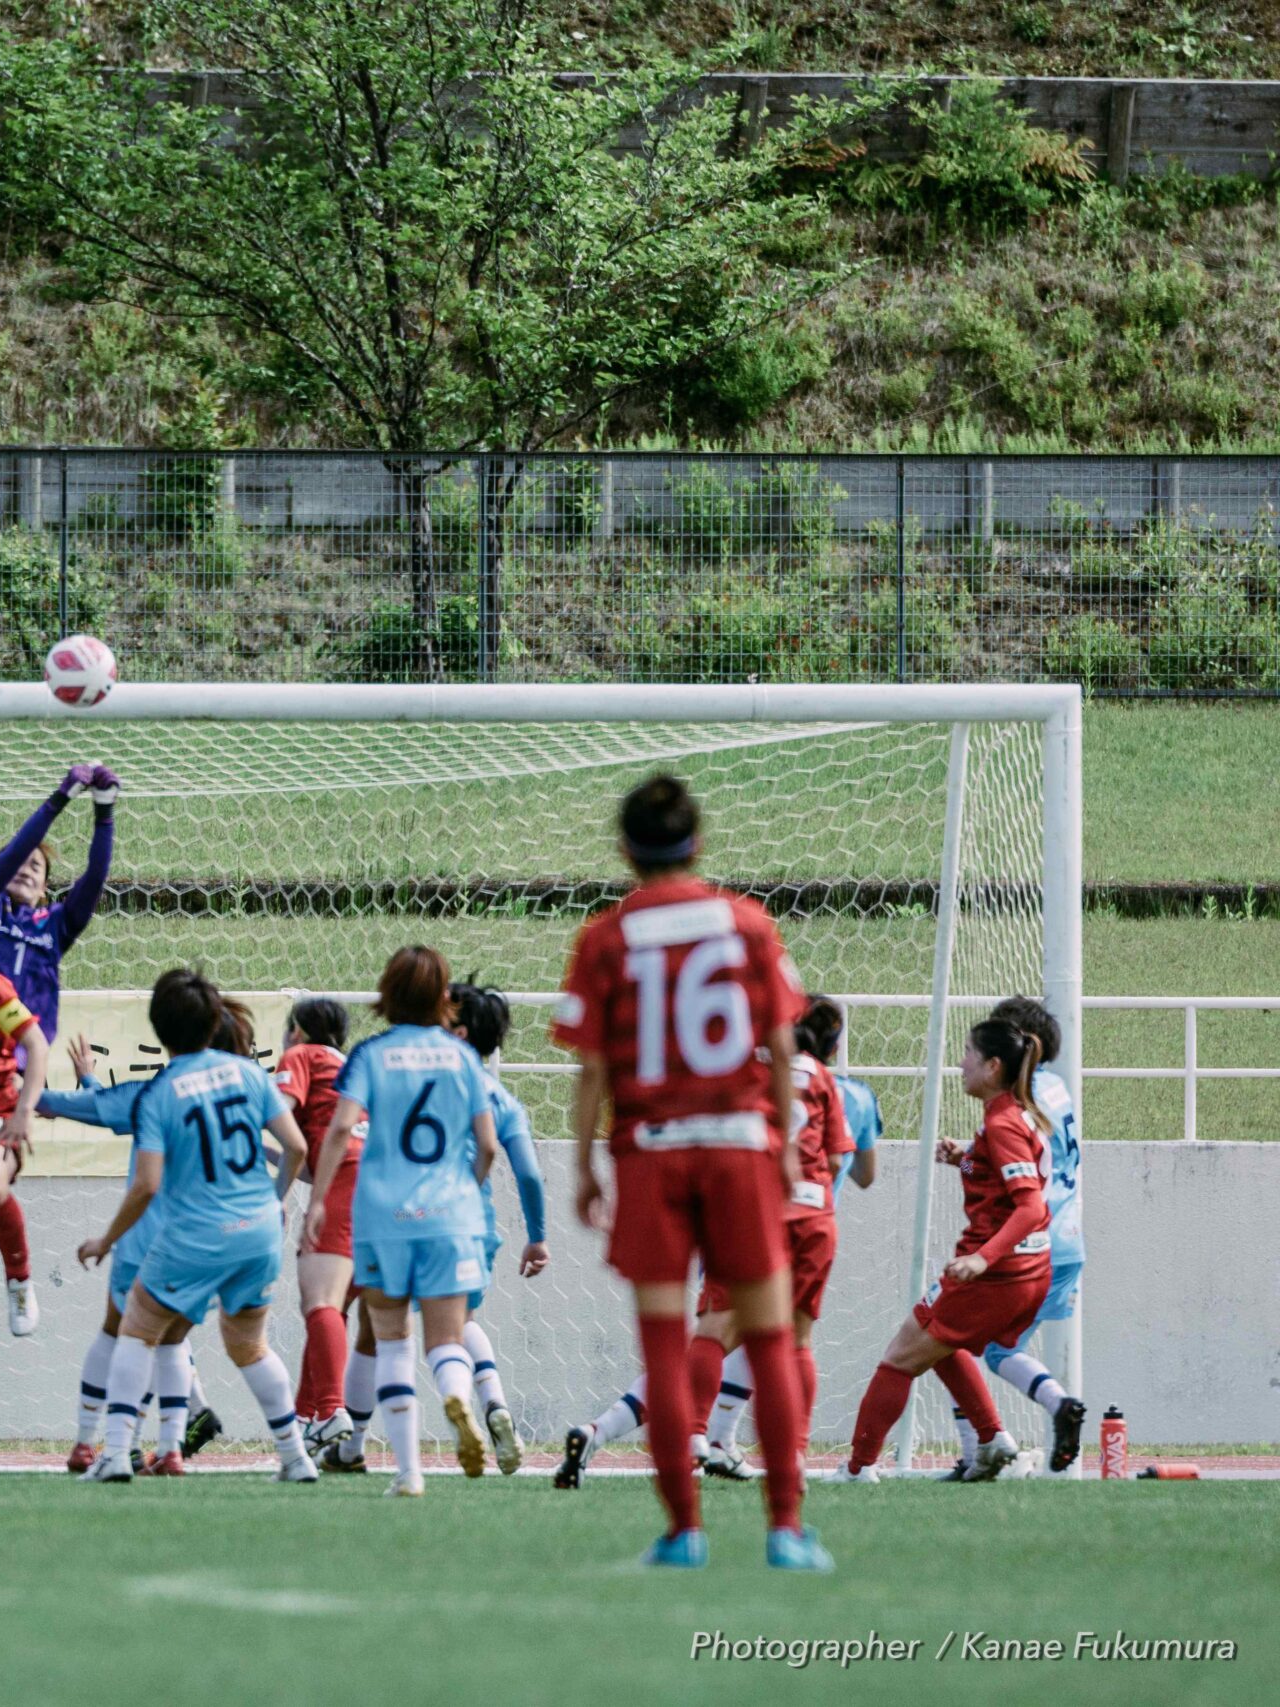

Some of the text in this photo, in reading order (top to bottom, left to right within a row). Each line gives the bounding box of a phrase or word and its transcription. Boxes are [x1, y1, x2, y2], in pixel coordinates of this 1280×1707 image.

[14, 942, 26, 975] 1
[624, 932, 754, 1086] 16
[184, 1095, 258, 1183] 15
[399, 1079, 446, 1164] 6
